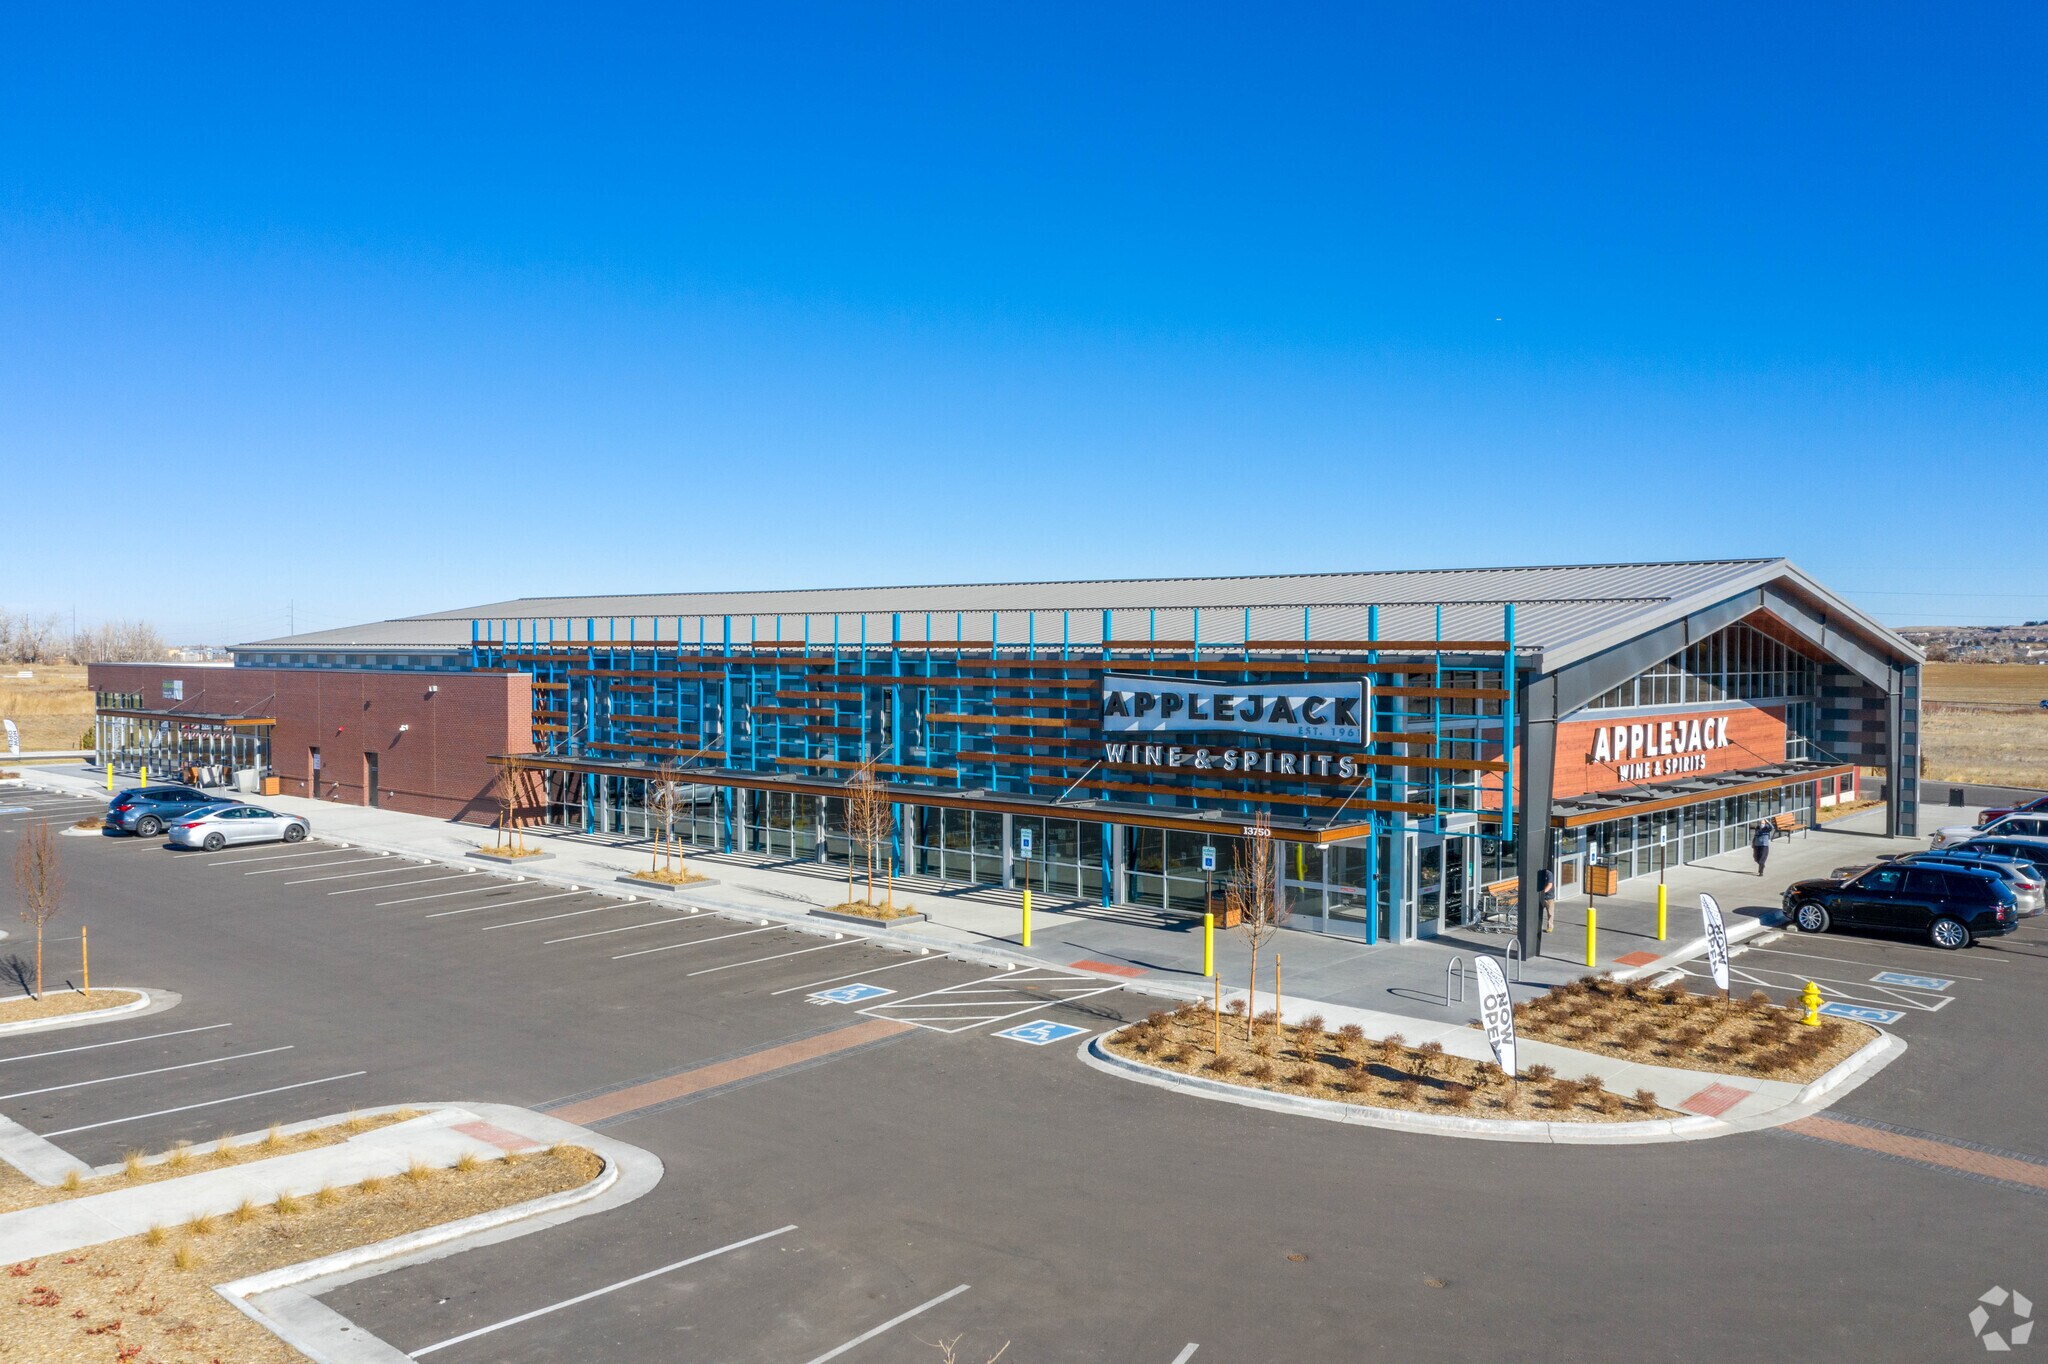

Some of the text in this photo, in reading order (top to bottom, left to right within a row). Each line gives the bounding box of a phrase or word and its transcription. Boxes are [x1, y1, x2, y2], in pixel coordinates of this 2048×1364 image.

[1104, 691, 1360, 726] APPLEJACK
[1298, 726, 1323, 736] EST.
[1592, 716, 1729, 762] APPLEJACK
[1105, 743, 1355, 778] WINE & SPIRITS
[1619, 754, 1706, 782] WINE & SPIRITS
[1243, 826, 1271, 837] 13750
[1707, 923, 1718, 975] OPEN
[1715, 924, 1727, 965] NOW
[1497, 991, 1513, 1045] NOW
